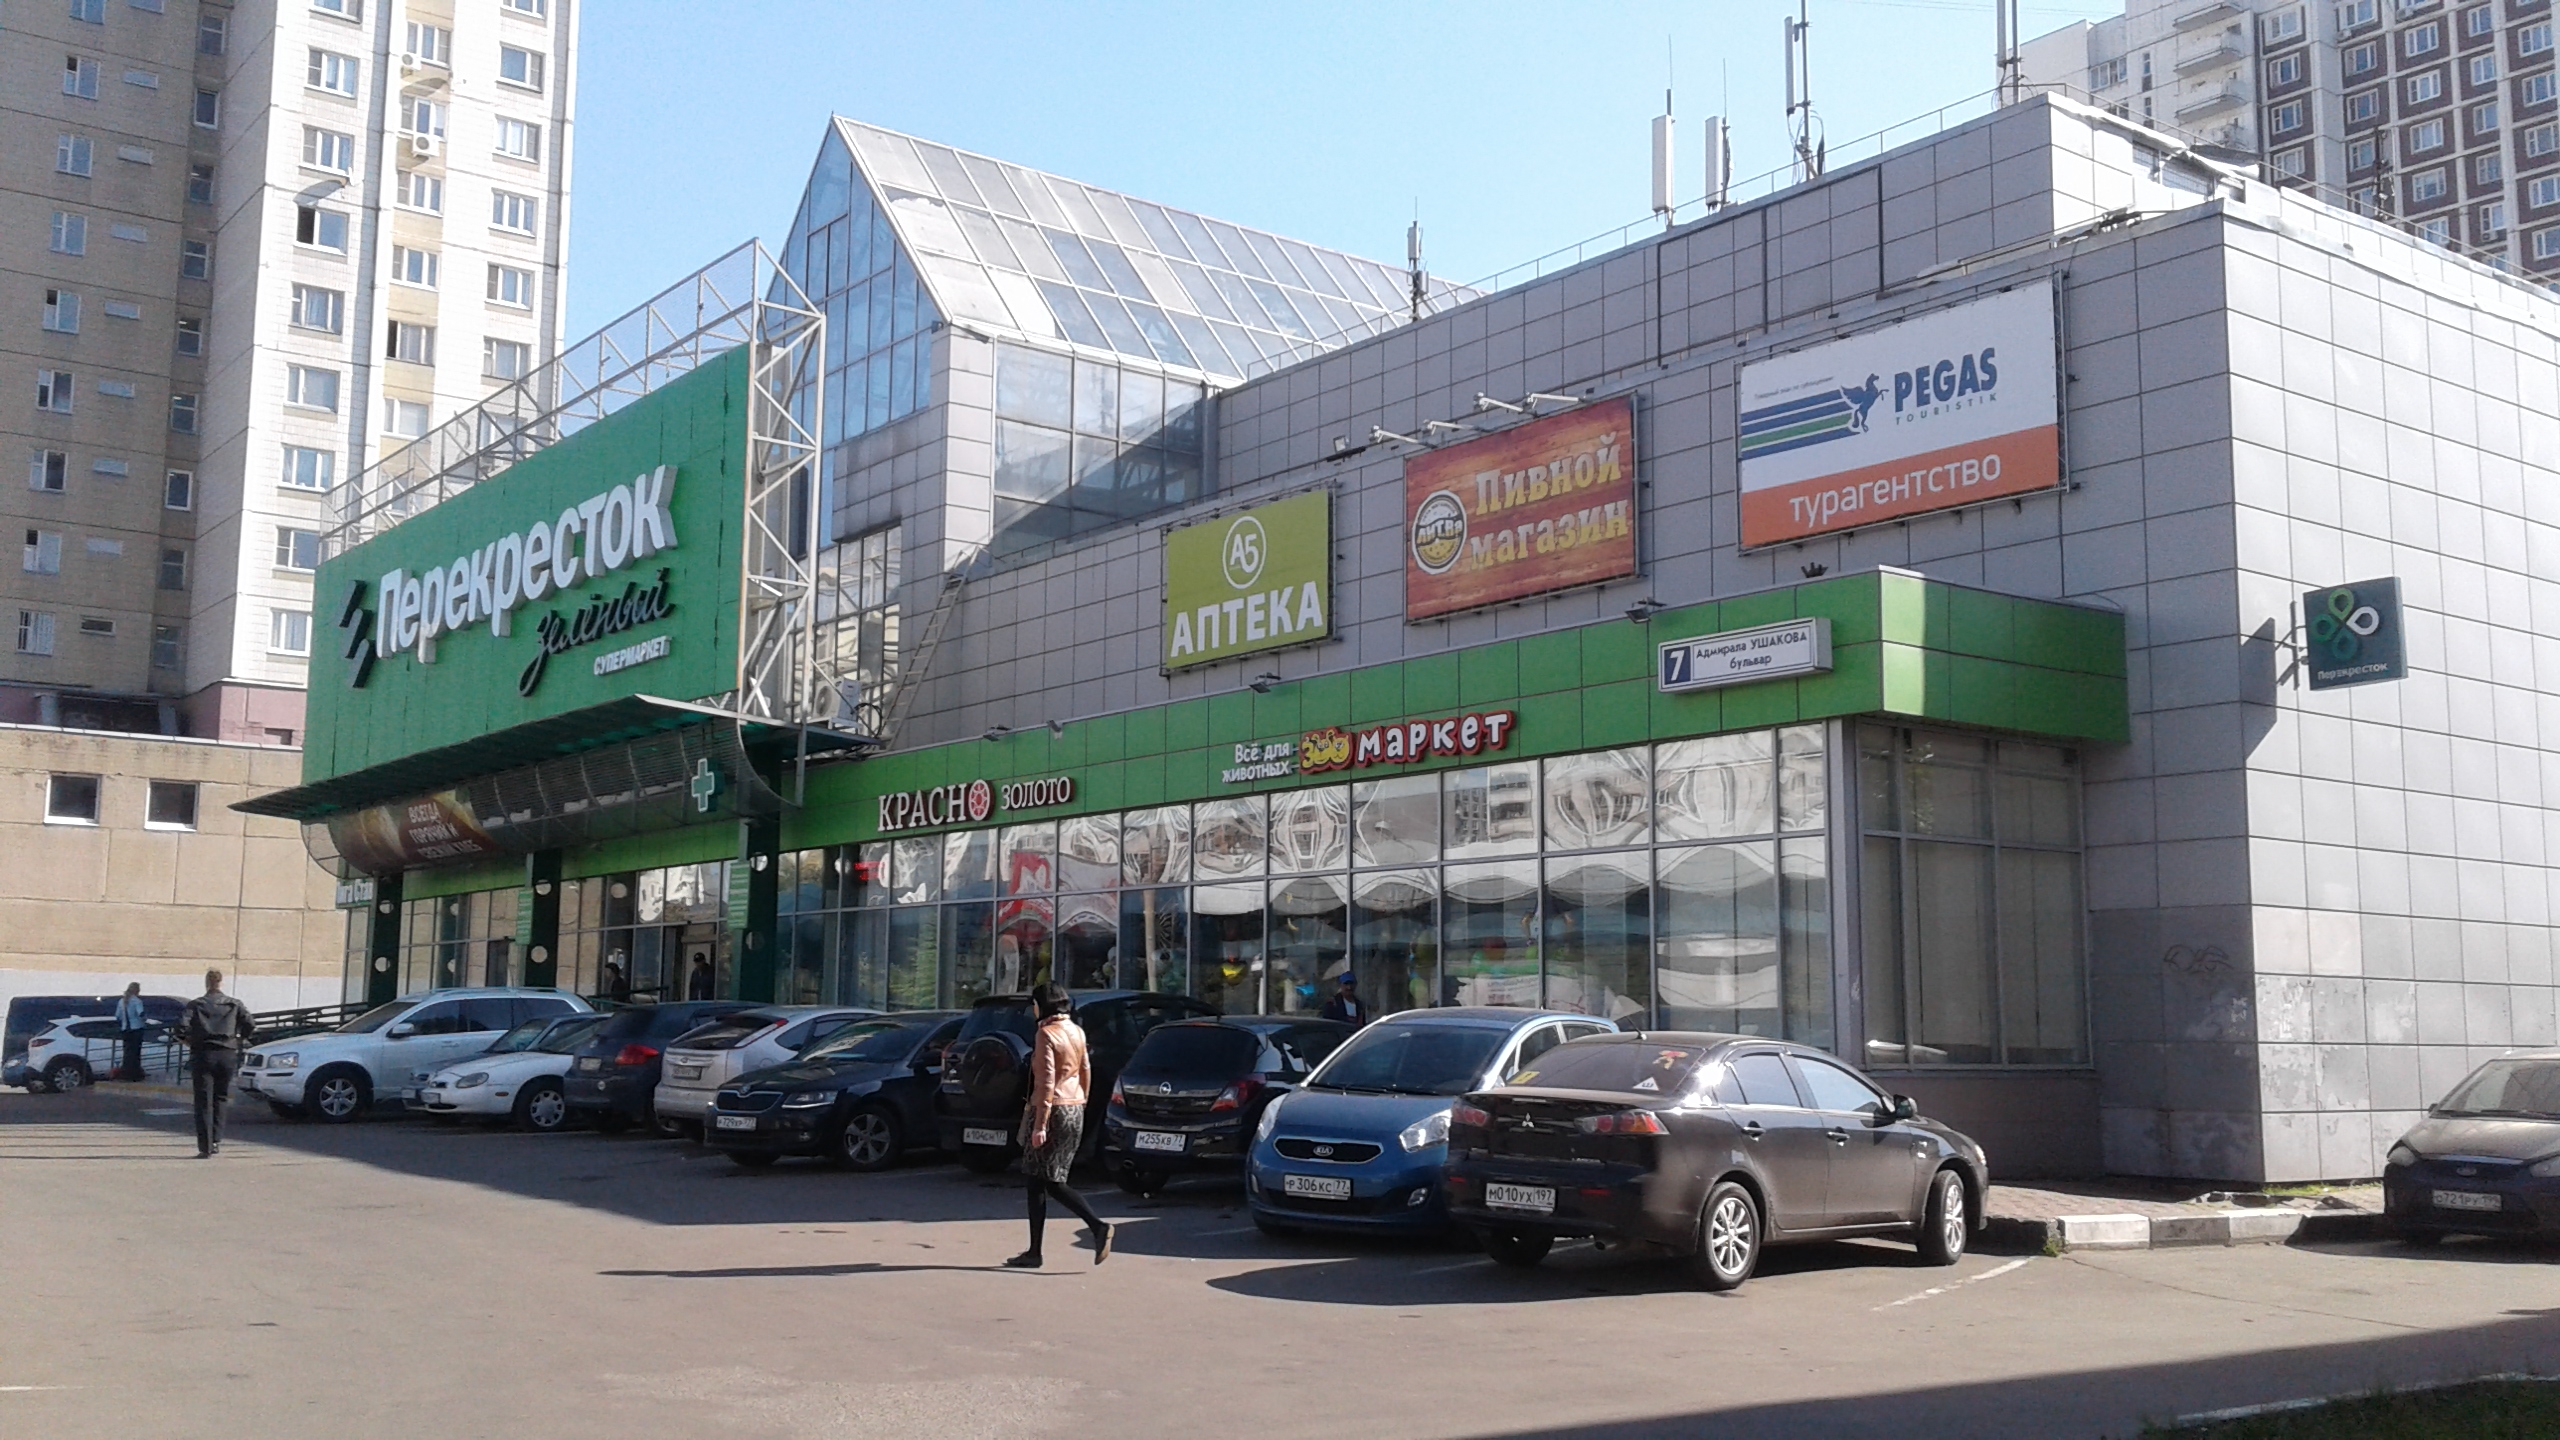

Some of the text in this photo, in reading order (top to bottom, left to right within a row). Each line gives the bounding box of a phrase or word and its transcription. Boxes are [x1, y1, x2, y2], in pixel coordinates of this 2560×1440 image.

[1894, 347, 1998, 413] PEGAS
[1895, 392, 1997, 426] TOURISTIK
[1475, 431, 1623, 517] Пивной
[1230, 533, 1260, 574] А5
[1470, 499, 1630, 570] магазин
[376, 464, 676, 664] Перекресток
[1170, 580, 1324, 658] АПТЕКА
[593, 635, 673, 676] СУПЕРМАРКЕТ
[1670, 650, 1686, 682] 7
[1695, 631, 1808, 660] Адмирала УШАКОВА
[1729, 655, 1773, 670] бульвар
[2317, 662, 2389, 680] Перекресток
[1234, 742, 1291, 764] Всё для
[1357, 712, 1509, 763] маркет
[1221, 760, 1291, 783] животных
[877, 776, 1073, 832] КРАСНО ЗОЛОТО
[1315, 1145, 1330, 1154] KIA
